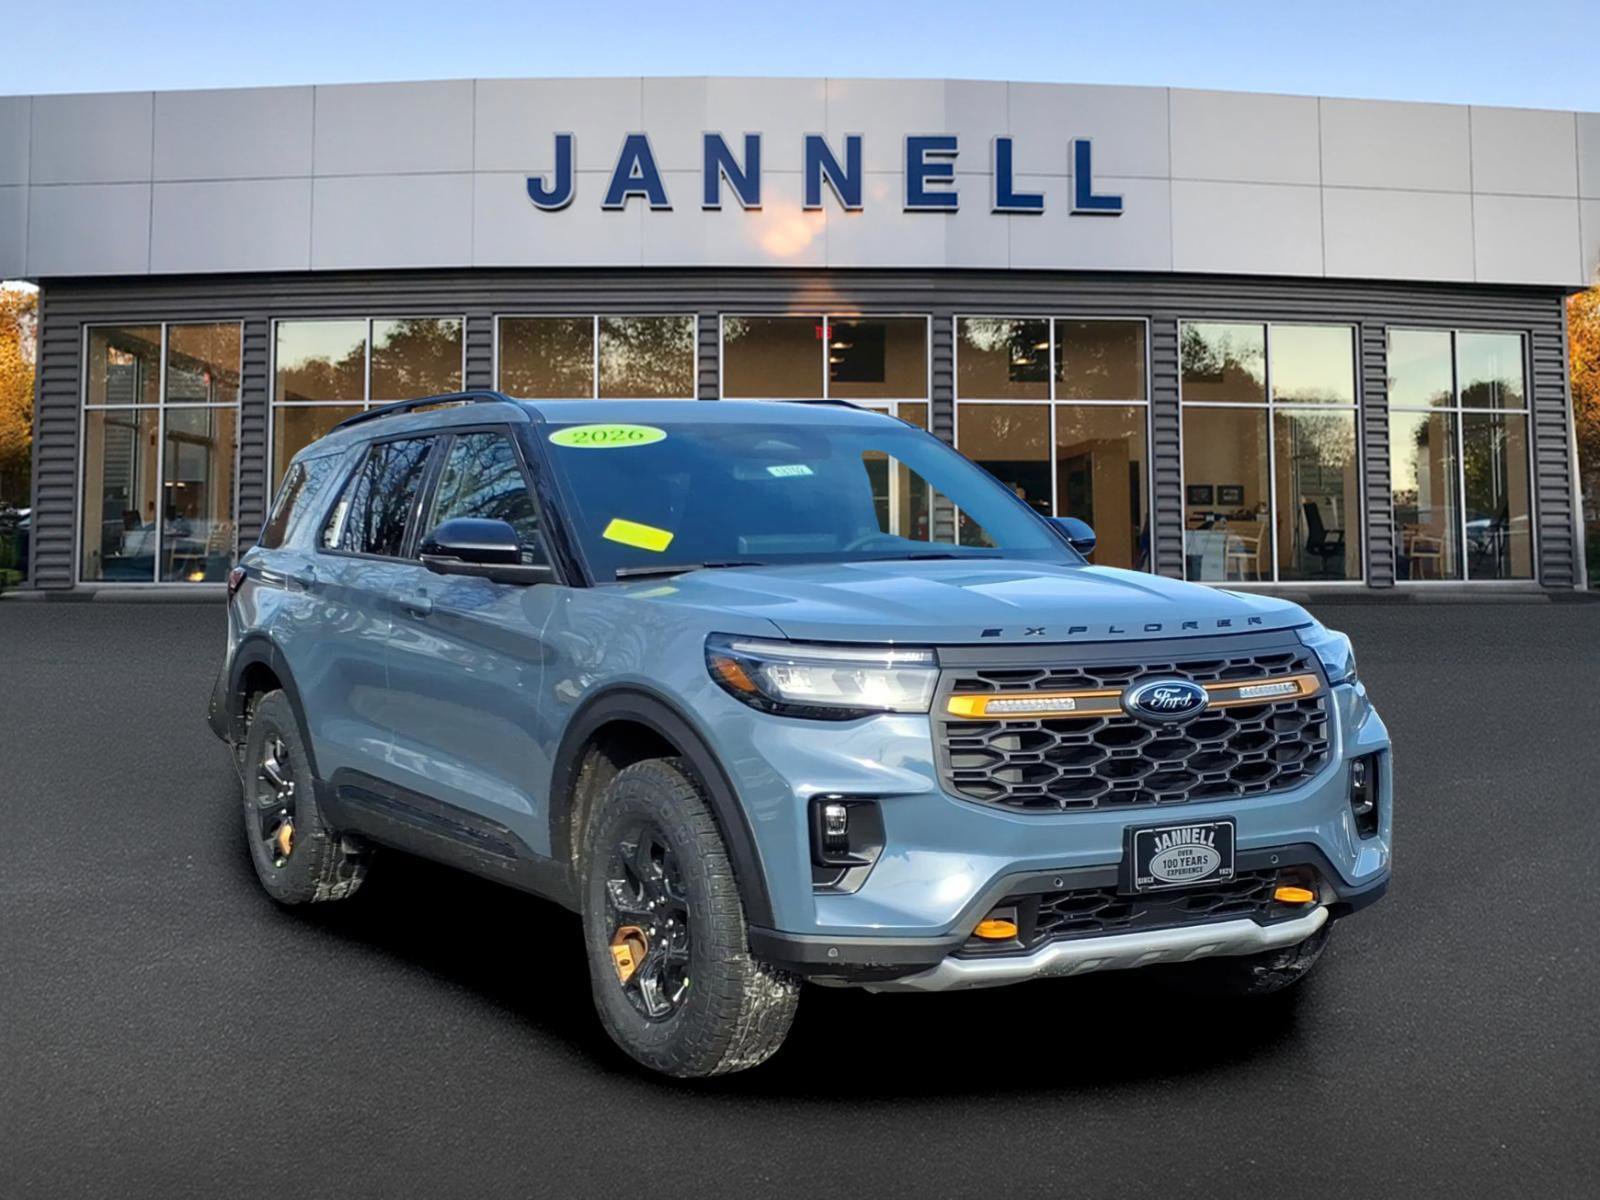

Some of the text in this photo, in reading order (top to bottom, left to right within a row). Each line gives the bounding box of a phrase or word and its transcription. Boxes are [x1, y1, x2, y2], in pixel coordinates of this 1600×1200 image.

[526, 131, 1124, 215] JANNELL
[573, 430, 644, 444] 2026
[981, 616, 1262, 637] EXPLORER
[1150, 688, 1192, 709] Ford
[1154, 828, 1215, 853] JANNELL
[1177, 849, 1193, 857] OVER
[1162, 855, 1208, 869] 100 YEARS
[1167, 867, 1203, 876] EXPERIENCE
